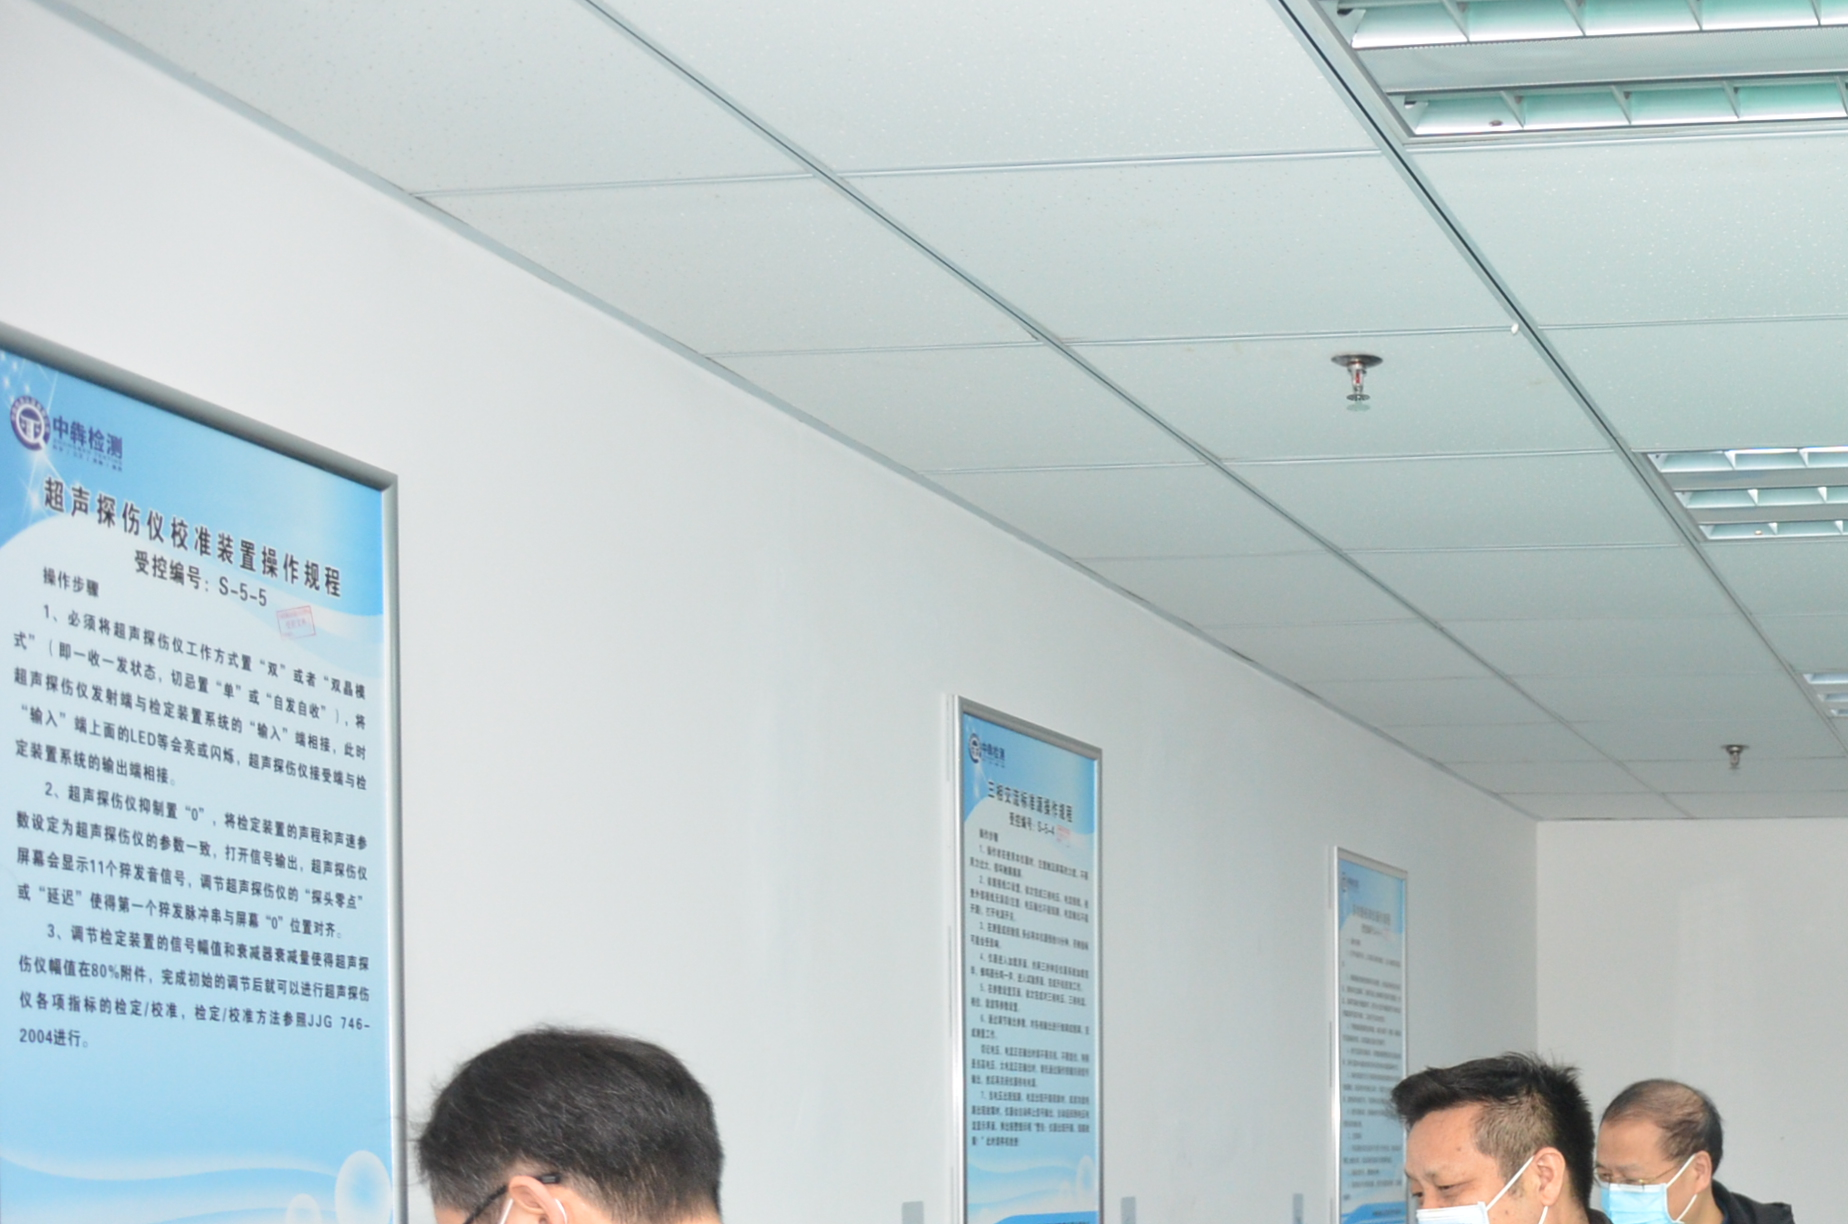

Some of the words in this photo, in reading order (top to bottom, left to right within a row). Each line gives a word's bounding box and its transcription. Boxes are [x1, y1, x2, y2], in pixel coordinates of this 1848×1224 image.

[44, 476, 342, 597] 超声探伤仪校准装置操作规程
[43, 566, 99, 598] 操作步骤
[15, 739, 176, 786] 定装置系统的输出端相接。
[19, 1028, 88, 1049] 2004进行。
